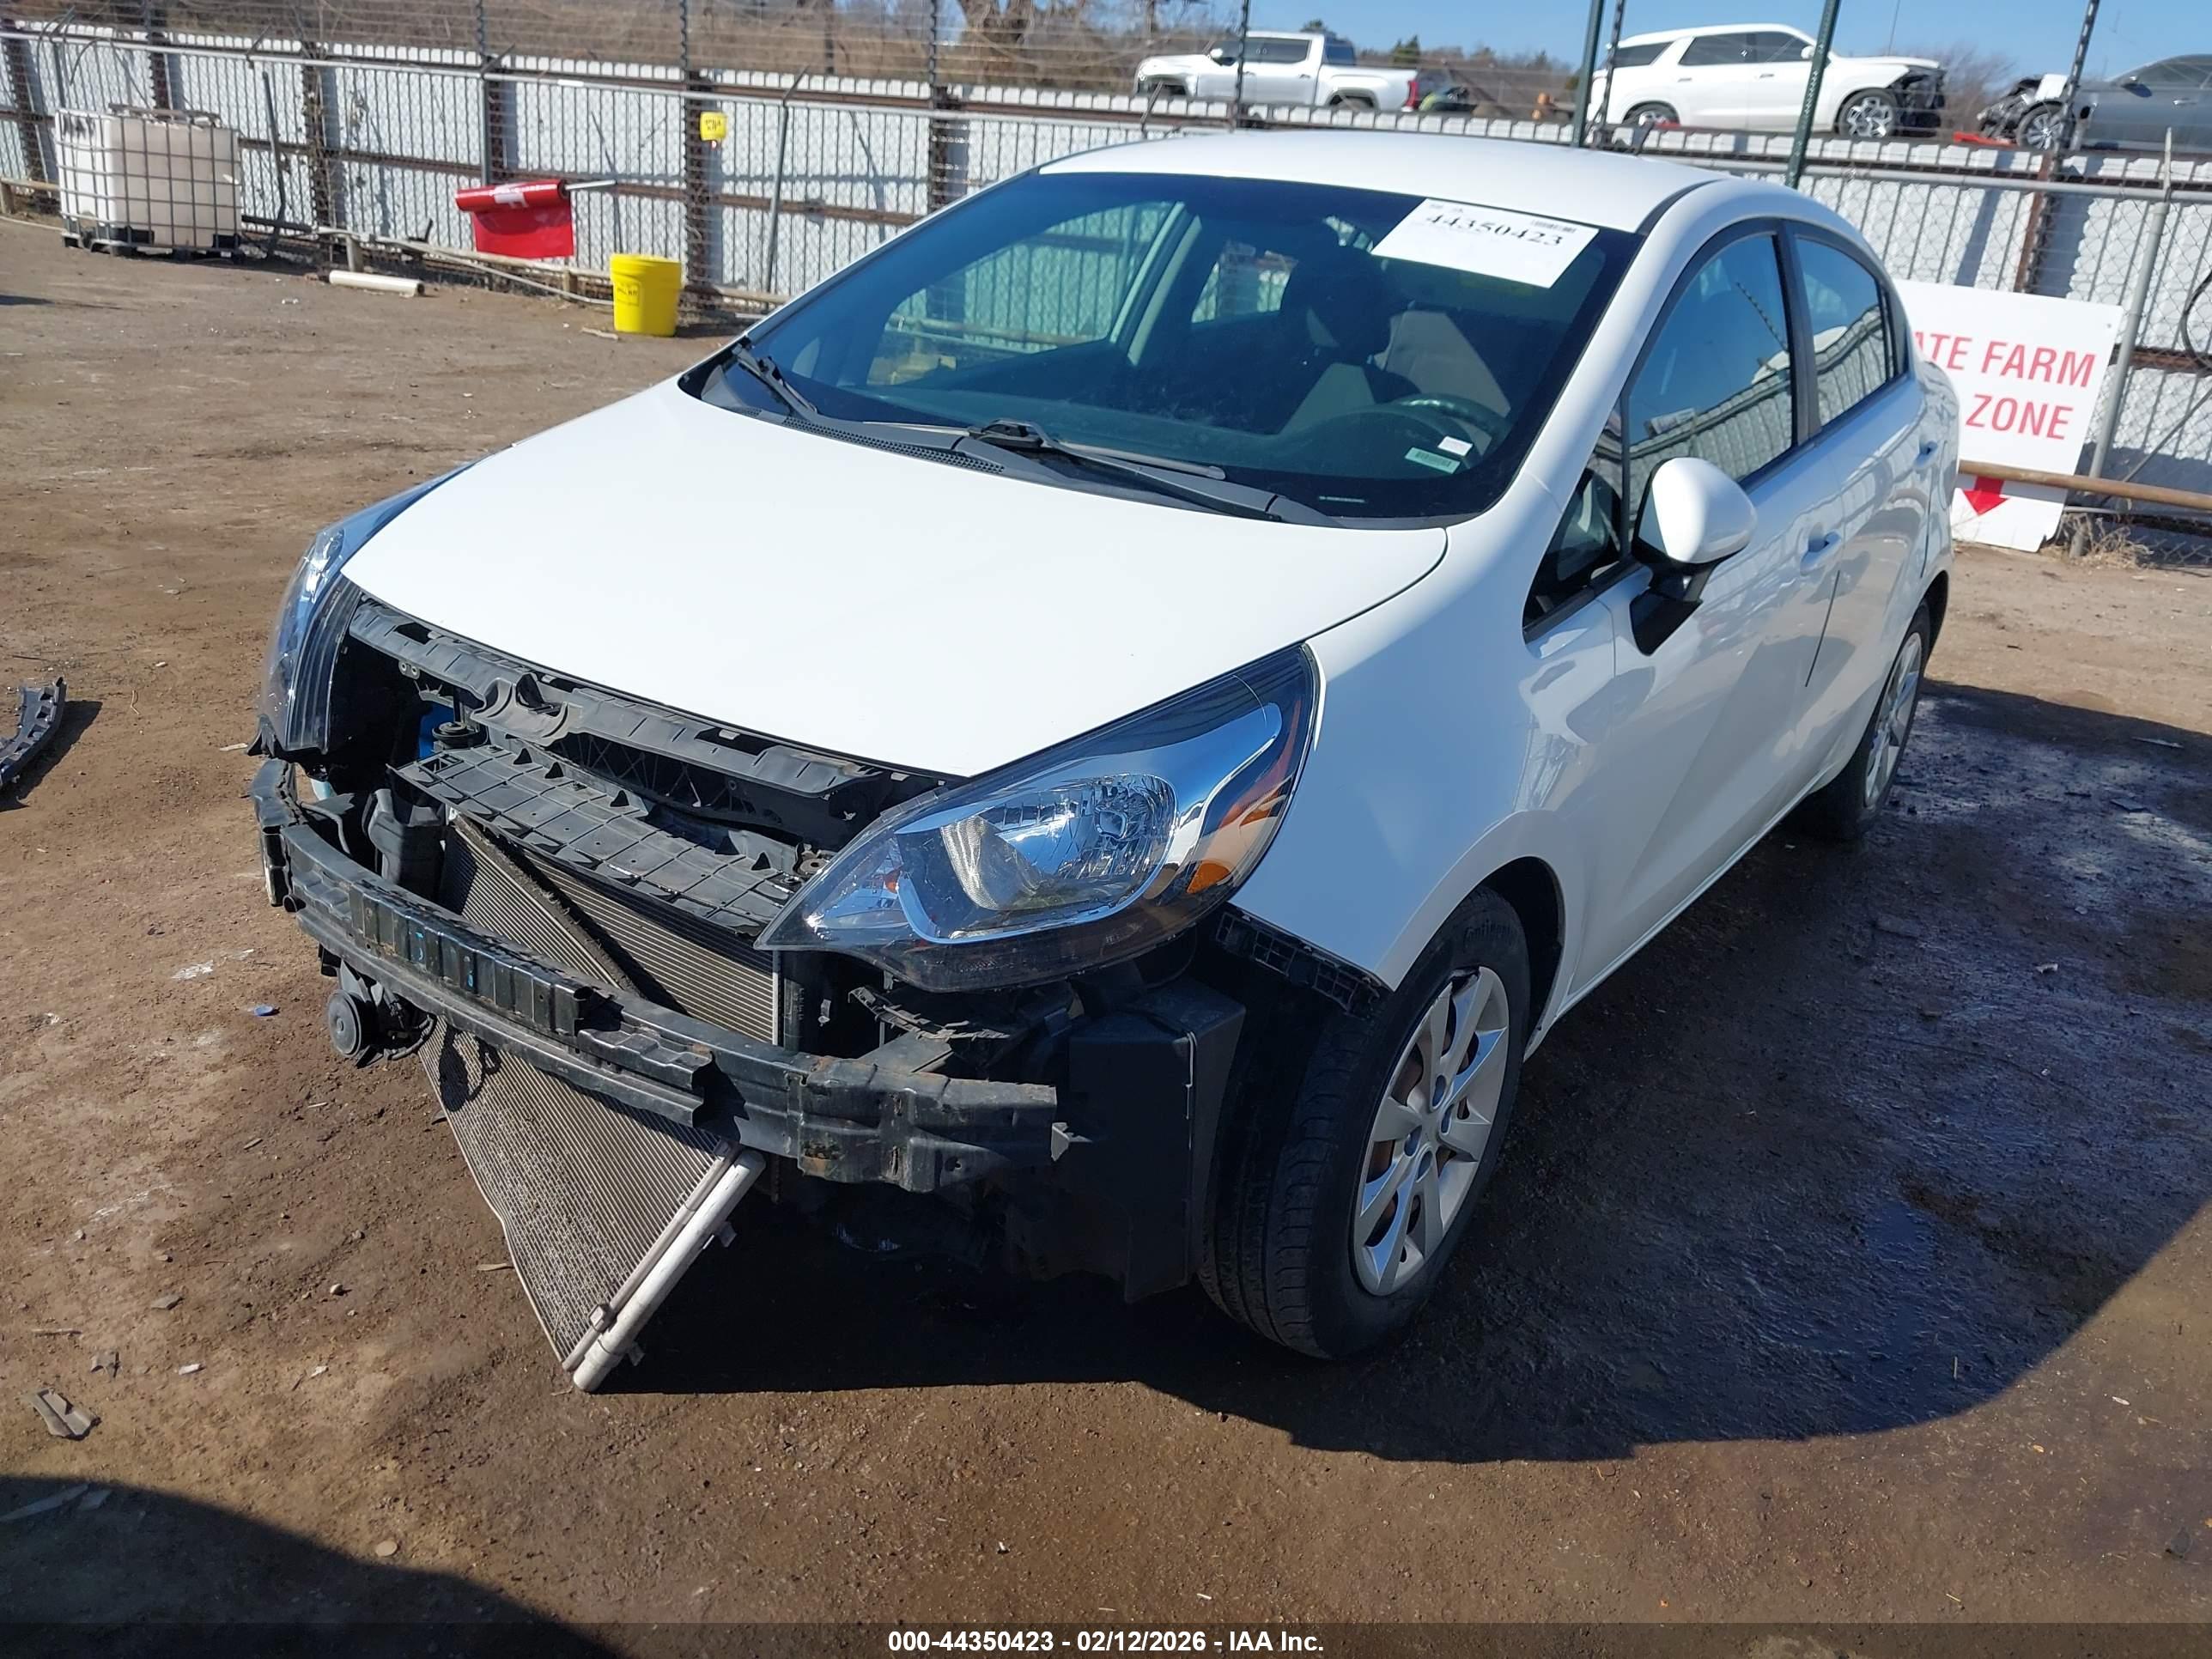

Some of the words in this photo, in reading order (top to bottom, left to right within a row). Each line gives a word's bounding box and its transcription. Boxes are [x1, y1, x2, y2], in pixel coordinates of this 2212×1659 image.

[1426, 214, 1563, 246] 44350423
[1981, 340, 2096, 388] FARM
[1966, 393, 2074, 441] ZONE
